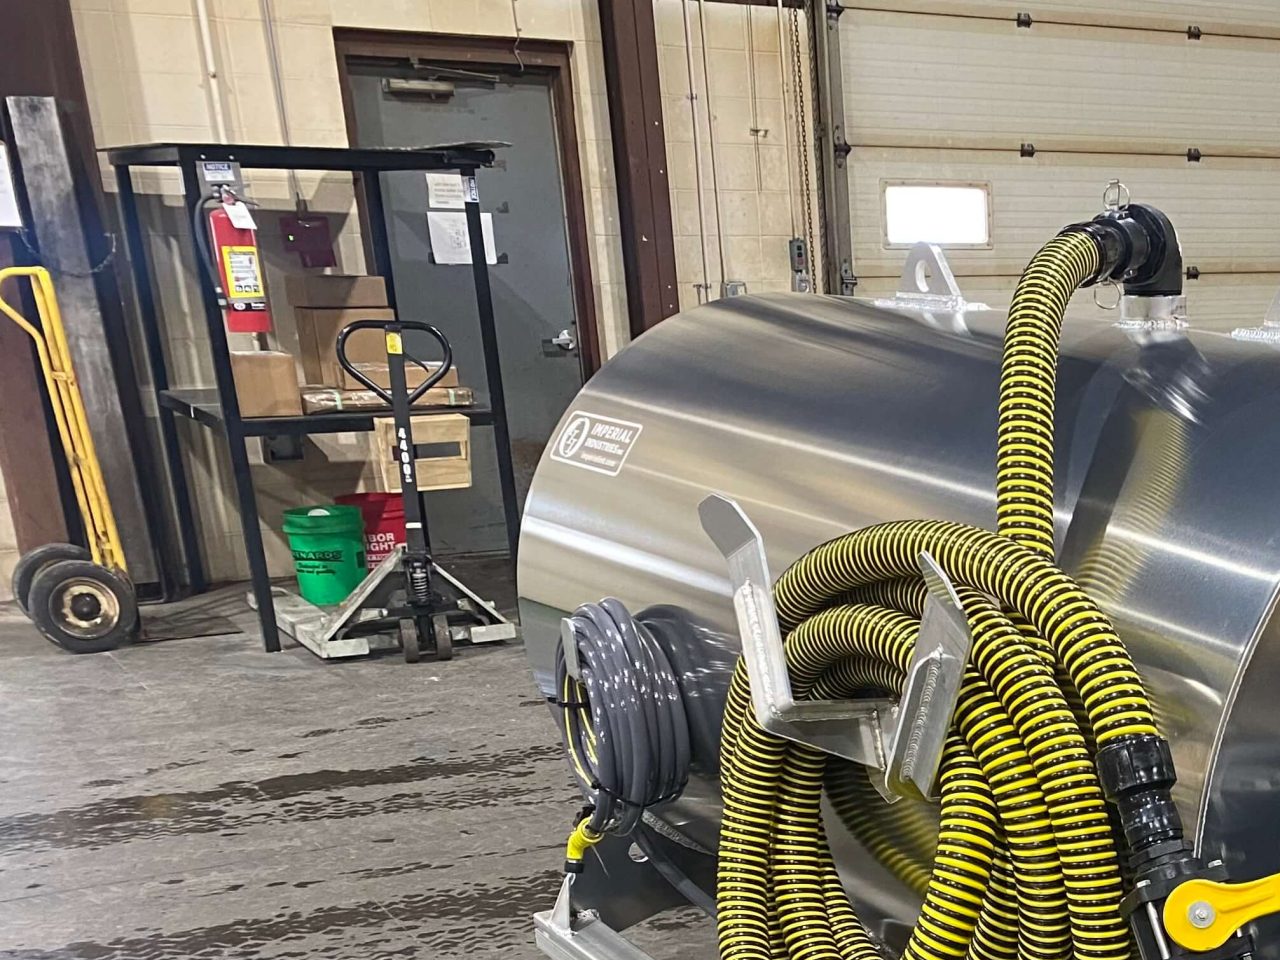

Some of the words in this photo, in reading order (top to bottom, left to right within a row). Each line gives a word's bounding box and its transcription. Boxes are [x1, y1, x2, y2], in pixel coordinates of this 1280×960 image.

[590, 422, 633, 443] IMPERIAL
[584, 437, 620, 454] INDUSTRIES
[367, 532, 395, 542] BOR
[293, 551, 341, 560] NARDS
